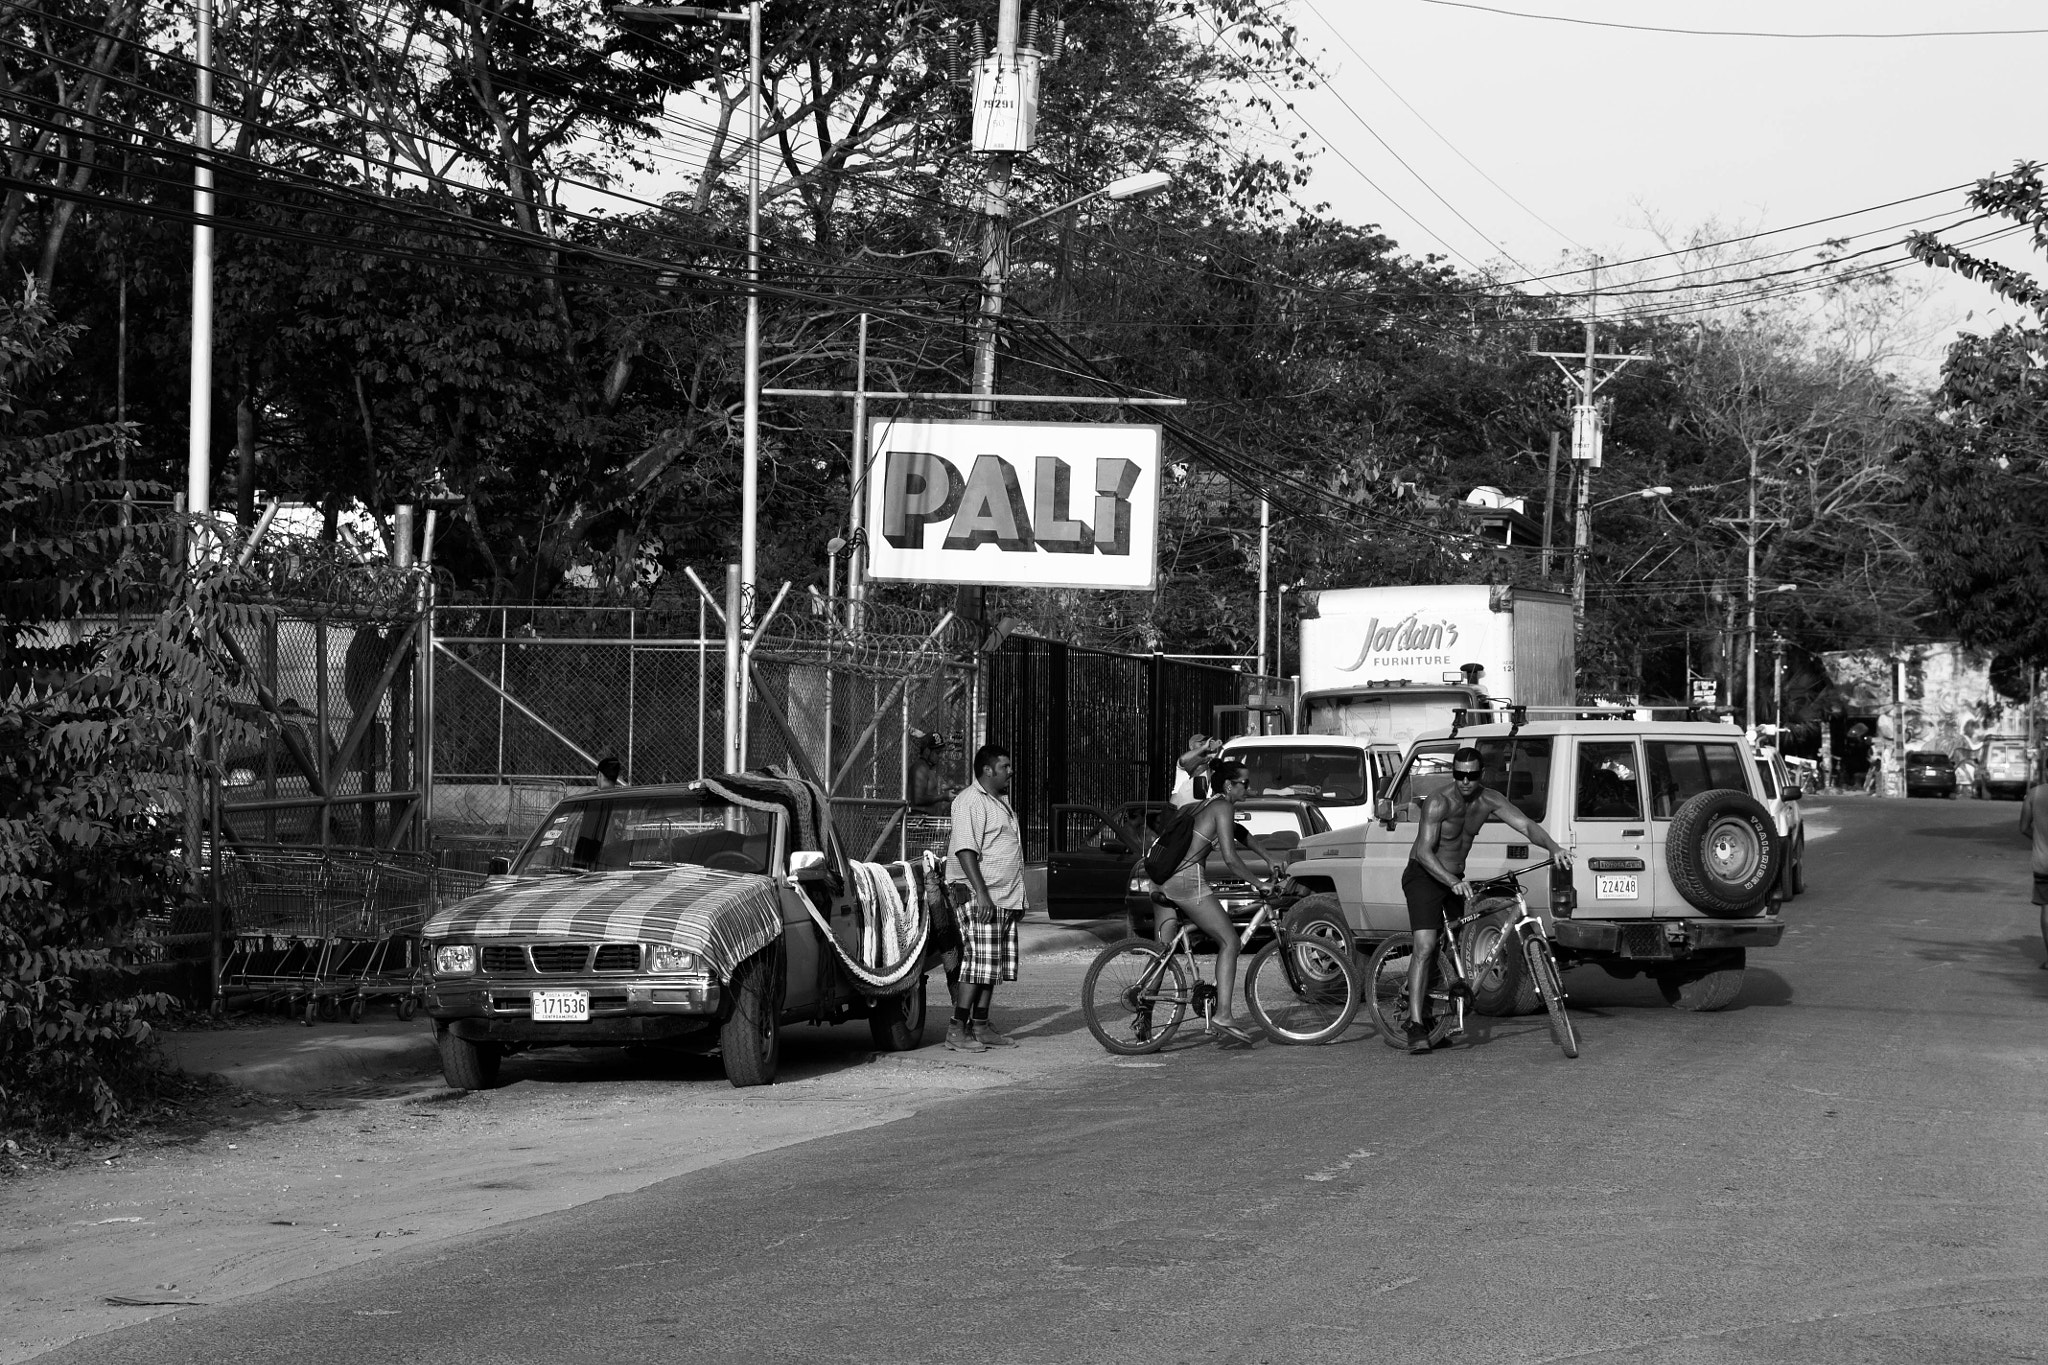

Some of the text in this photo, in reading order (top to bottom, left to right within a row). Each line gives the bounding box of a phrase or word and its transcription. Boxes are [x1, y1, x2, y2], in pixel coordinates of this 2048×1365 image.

[983, 99, 1014, 109] 79291
[1335, 607, 1459, 672] Jordan's
[1374, 655, 1451, 667] FURNITURE
[1602, 880, 1636, 893] 224248
[542, 998, 586, 1014] 171536
